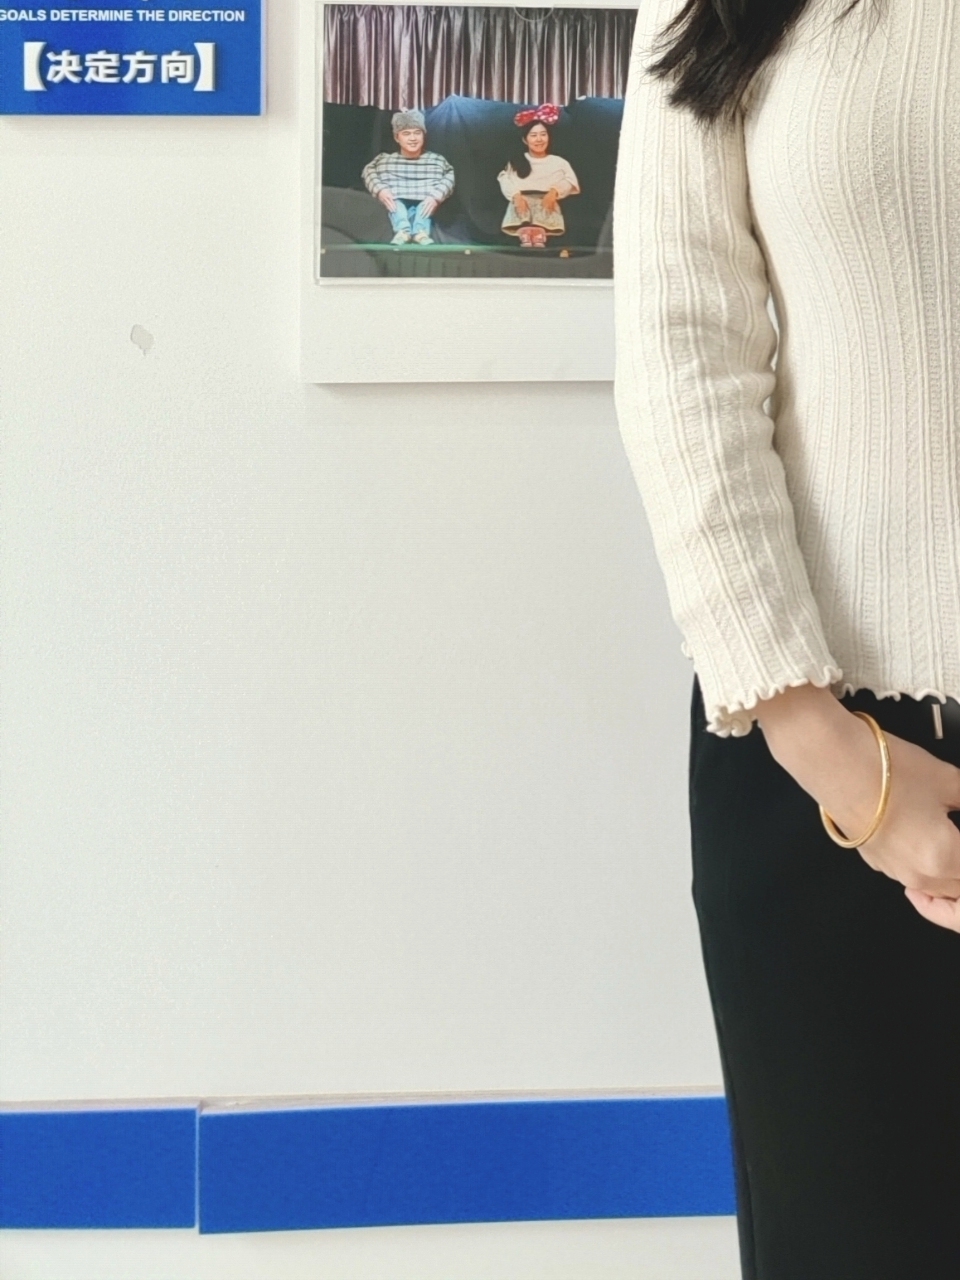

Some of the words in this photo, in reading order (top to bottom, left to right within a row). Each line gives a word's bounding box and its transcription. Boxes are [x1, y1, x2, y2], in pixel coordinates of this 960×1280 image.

[0, 9, 47, 22] GOALS
[50, 9, 133, 22] DETERMINE
[137, 9, 165, 22] THE
[168, 9, 245, 22] DIRECTION
[23, 41, 215, 92] 【决定方向】
